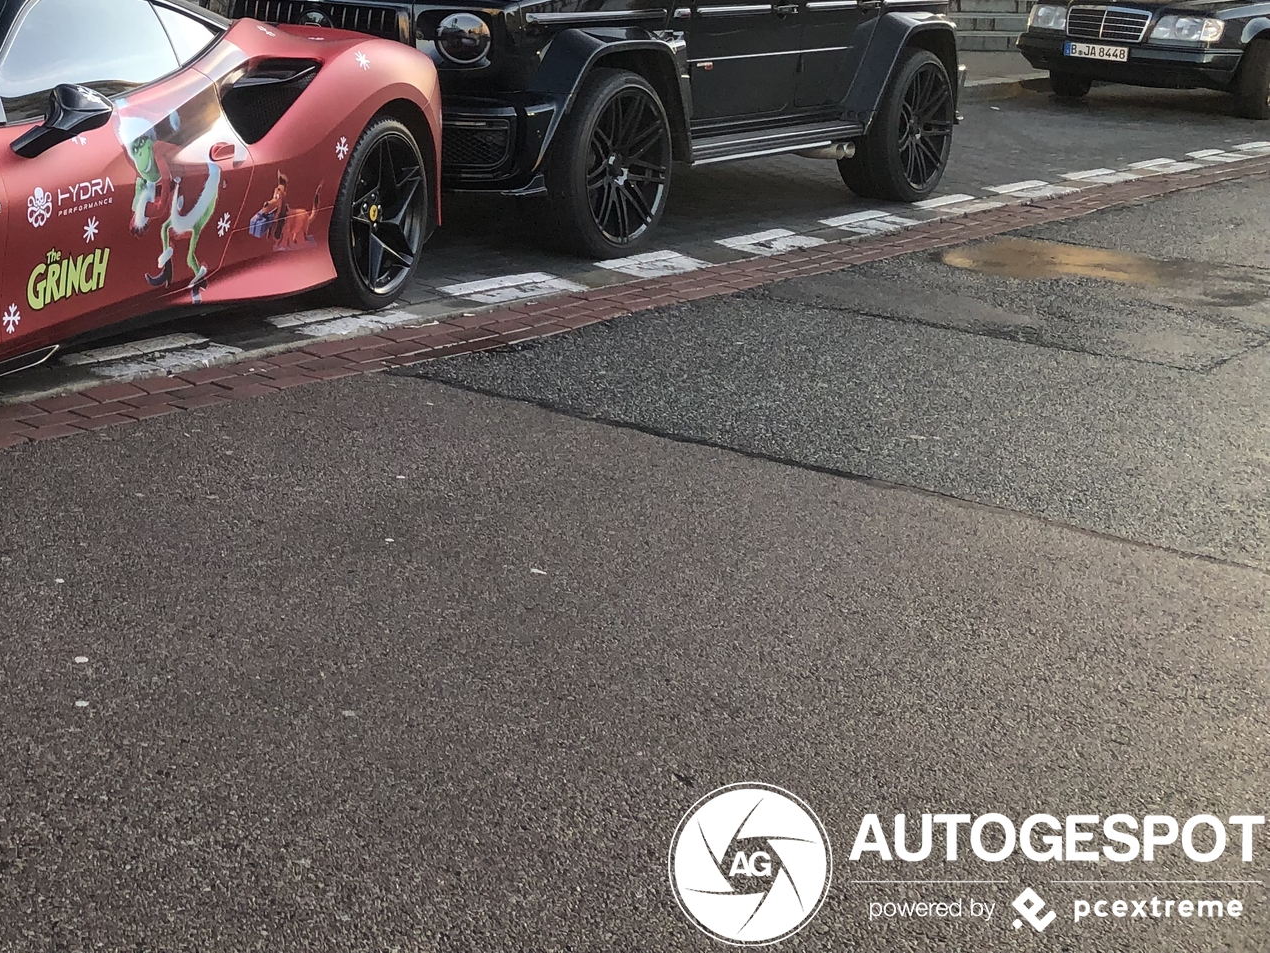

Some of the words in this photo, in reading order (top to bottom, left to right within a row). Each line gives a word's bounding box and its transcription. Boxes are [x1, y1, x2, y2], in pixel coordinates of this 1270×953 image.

[1071, 44, 1077, 55] B
[1083, 45, 1096, 57] JA
[1098, 47, 1126, 60] 8448
[57, 176, 115, 206] HYDRA
[57, 196, 113, 217] PERFORMANCE
[27, 248, 110, 310] GRINCH
